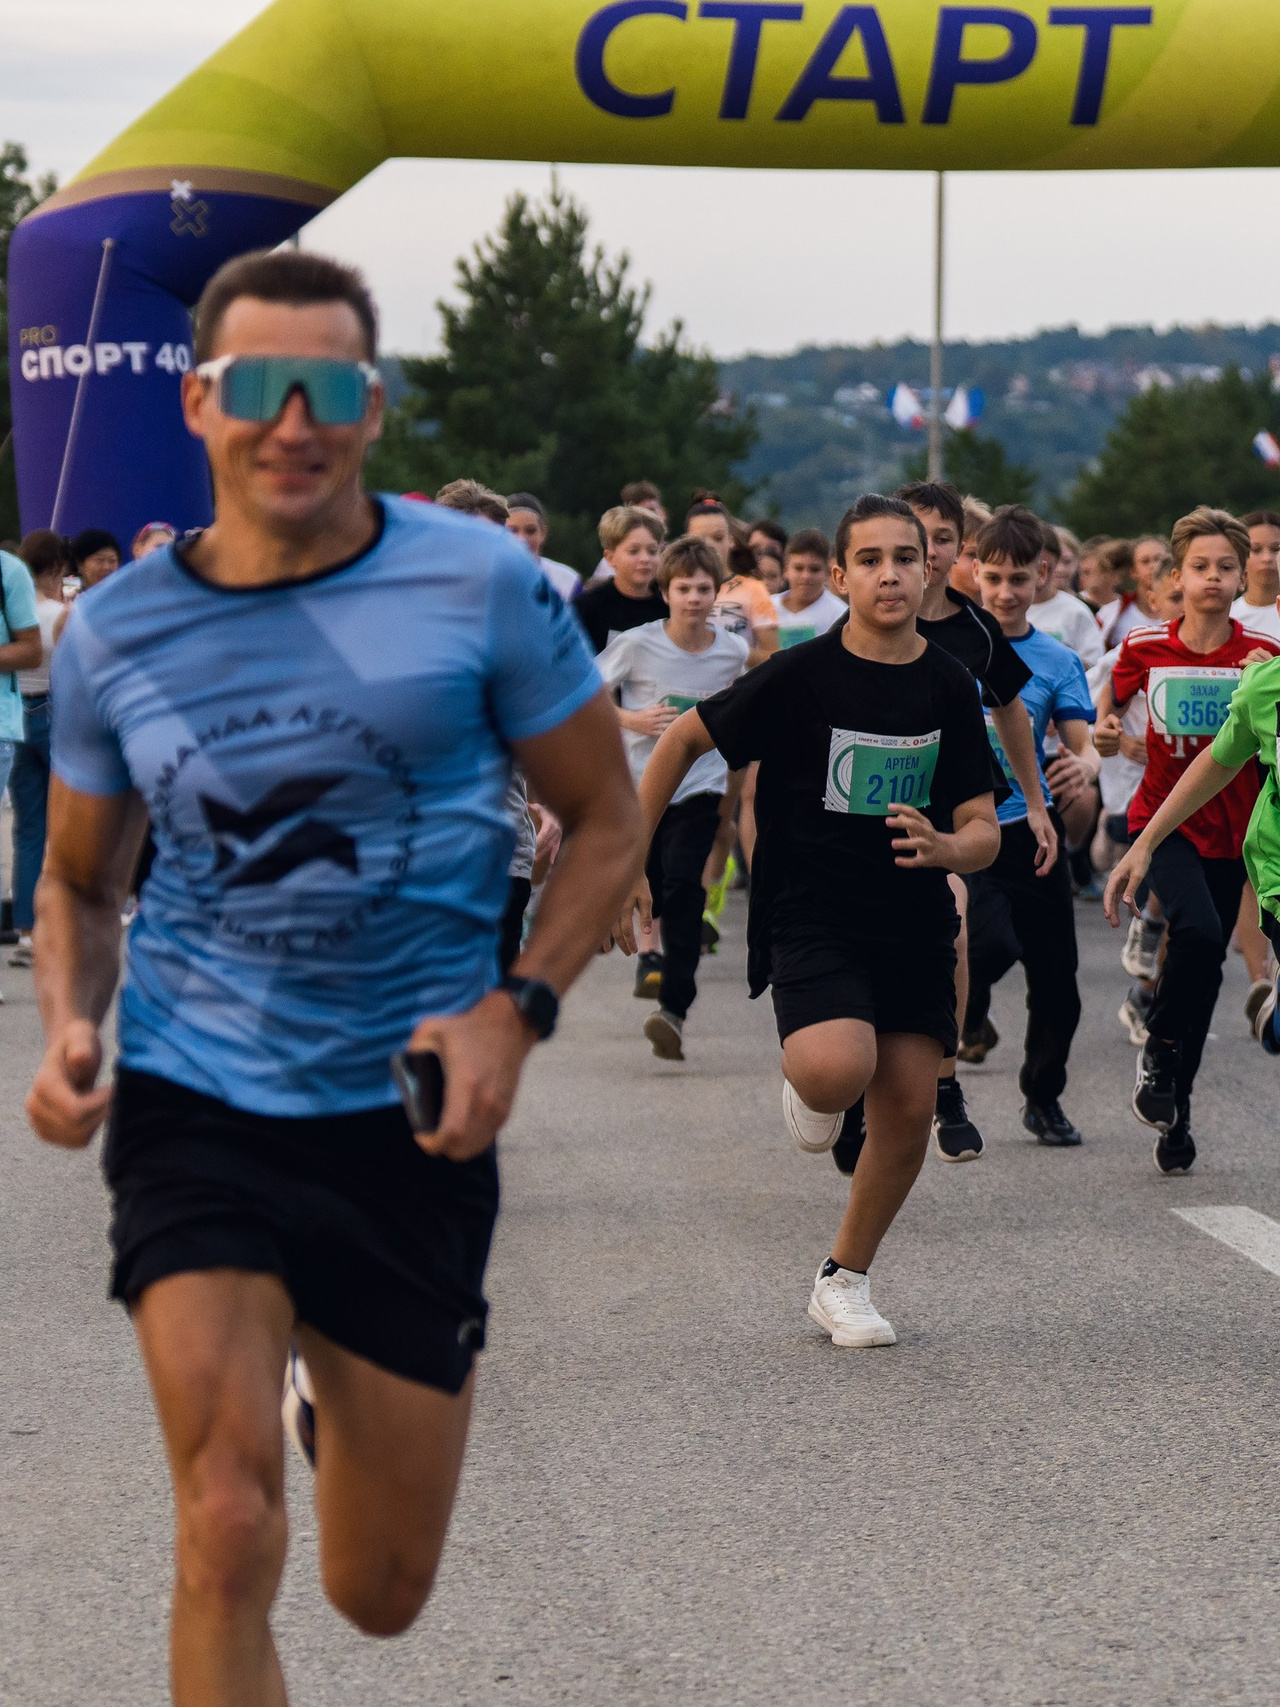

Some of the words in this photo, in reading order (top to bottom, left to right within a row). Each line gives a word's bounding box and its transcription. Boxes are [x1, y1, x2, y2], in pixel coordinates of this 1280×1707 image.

[574, 0, 1153, 126] СТАРТ
[20, 325, 57, 346] PRO
[21, 341, 148, 382] СПОРТ
[155, 342, 190, 374] 40
[1190, 684, 1220, 697] ЗАХАР
[885, 755, 919, 770] АРТЁМ
[866, 770, 926, 805] 2101
